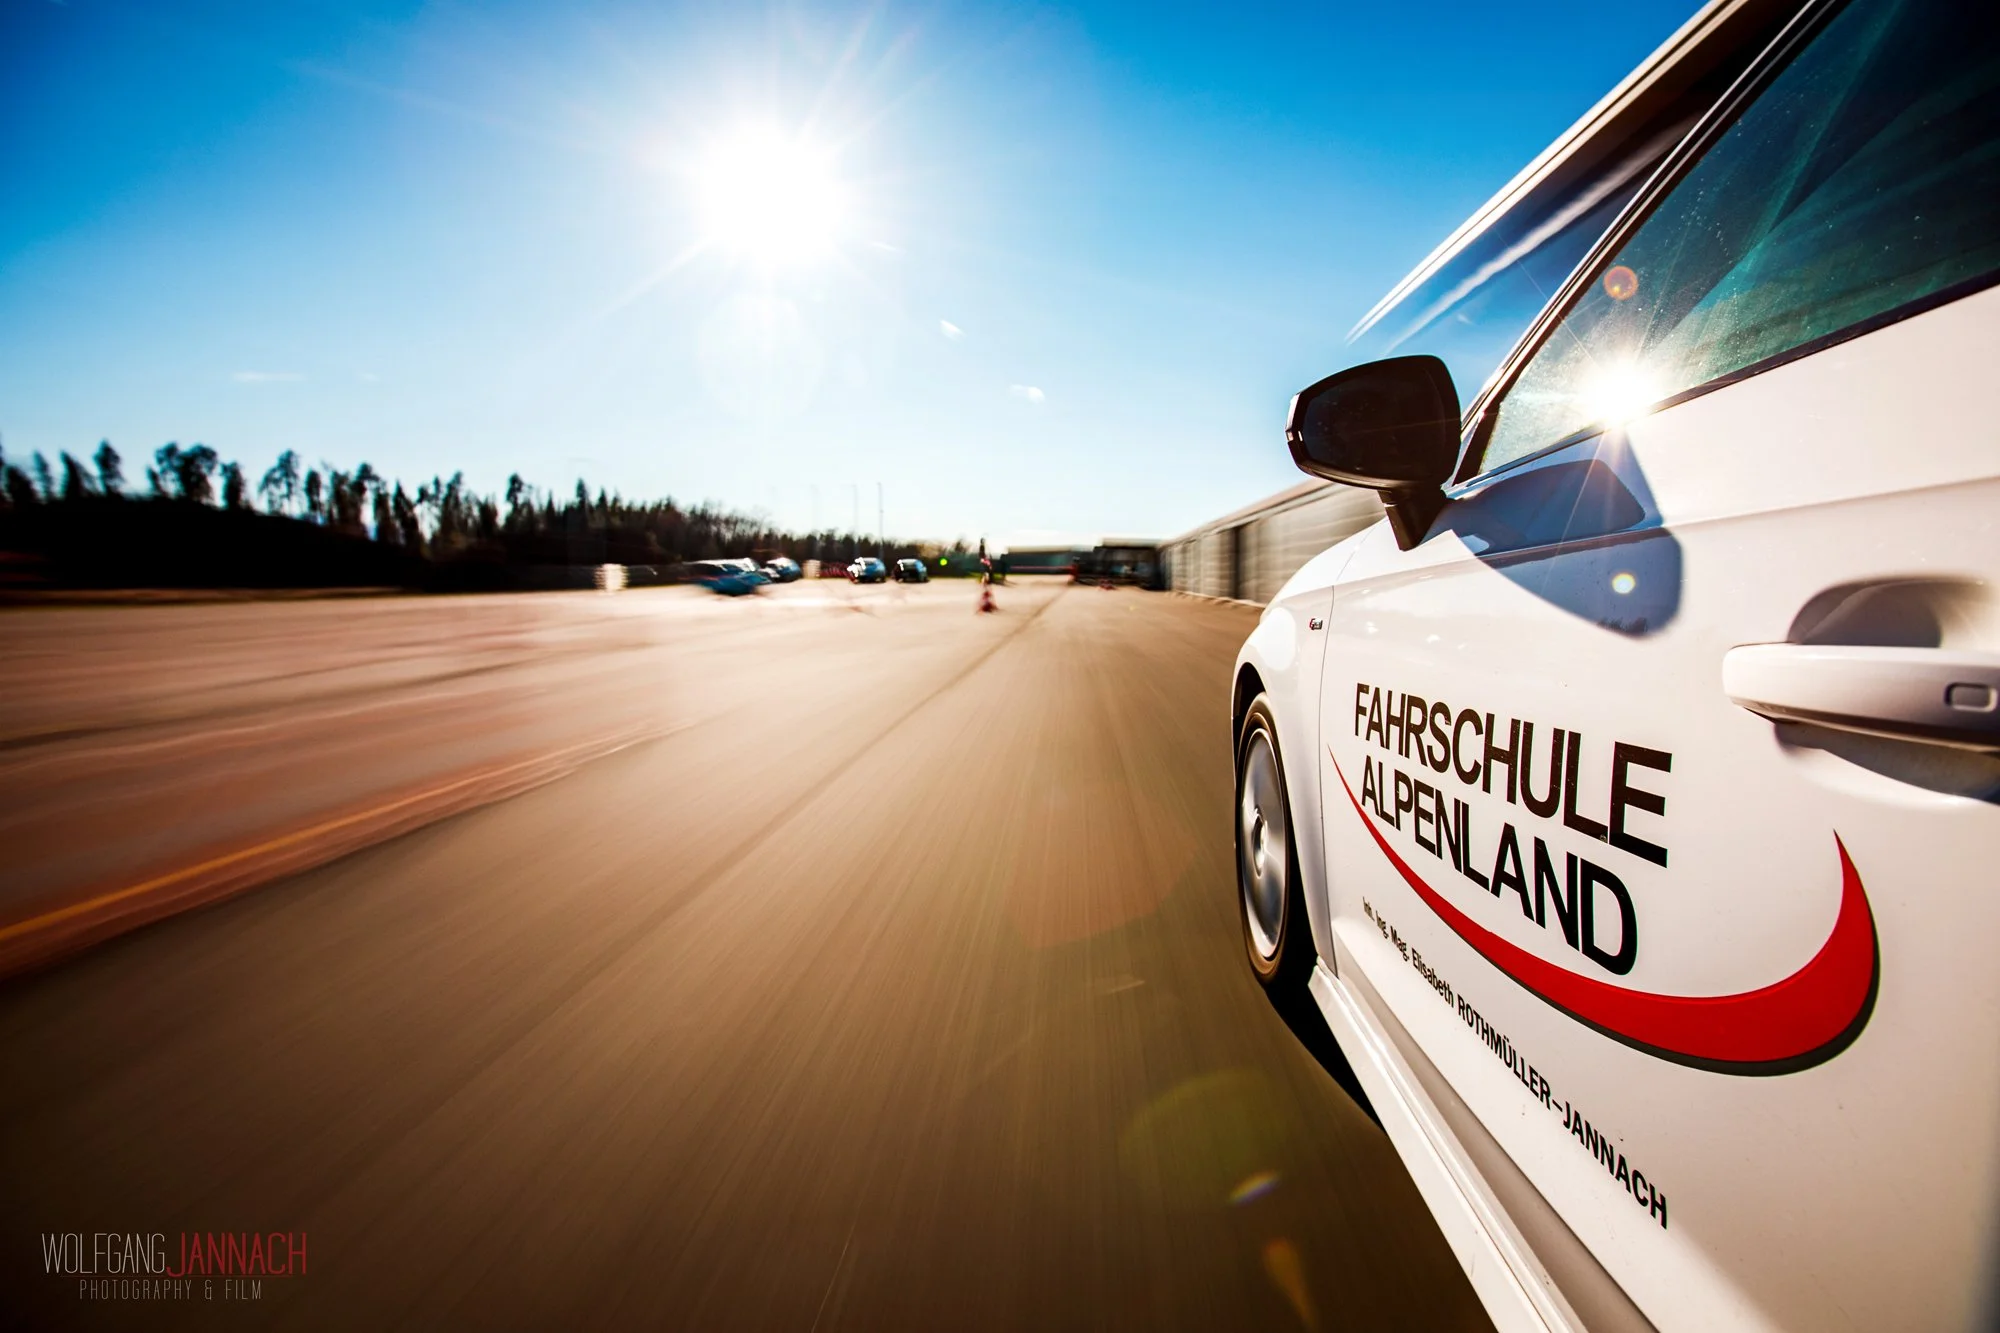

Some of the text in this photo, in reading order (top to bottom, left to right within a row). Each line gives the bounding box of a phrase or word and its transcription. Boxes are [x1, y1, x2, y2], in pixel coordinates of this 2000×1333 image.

[1355, 683, 1672, 868] FAHRSCHULE
[1361, 755, 1638, 976] ALPENLAND
[1390, 925, 1410, 962] Mag.
[1411, 947, 1454, 1008] Elisabeth
[1457, 993, 1668, 1230] ROTHMÜLLER-JANNACH
